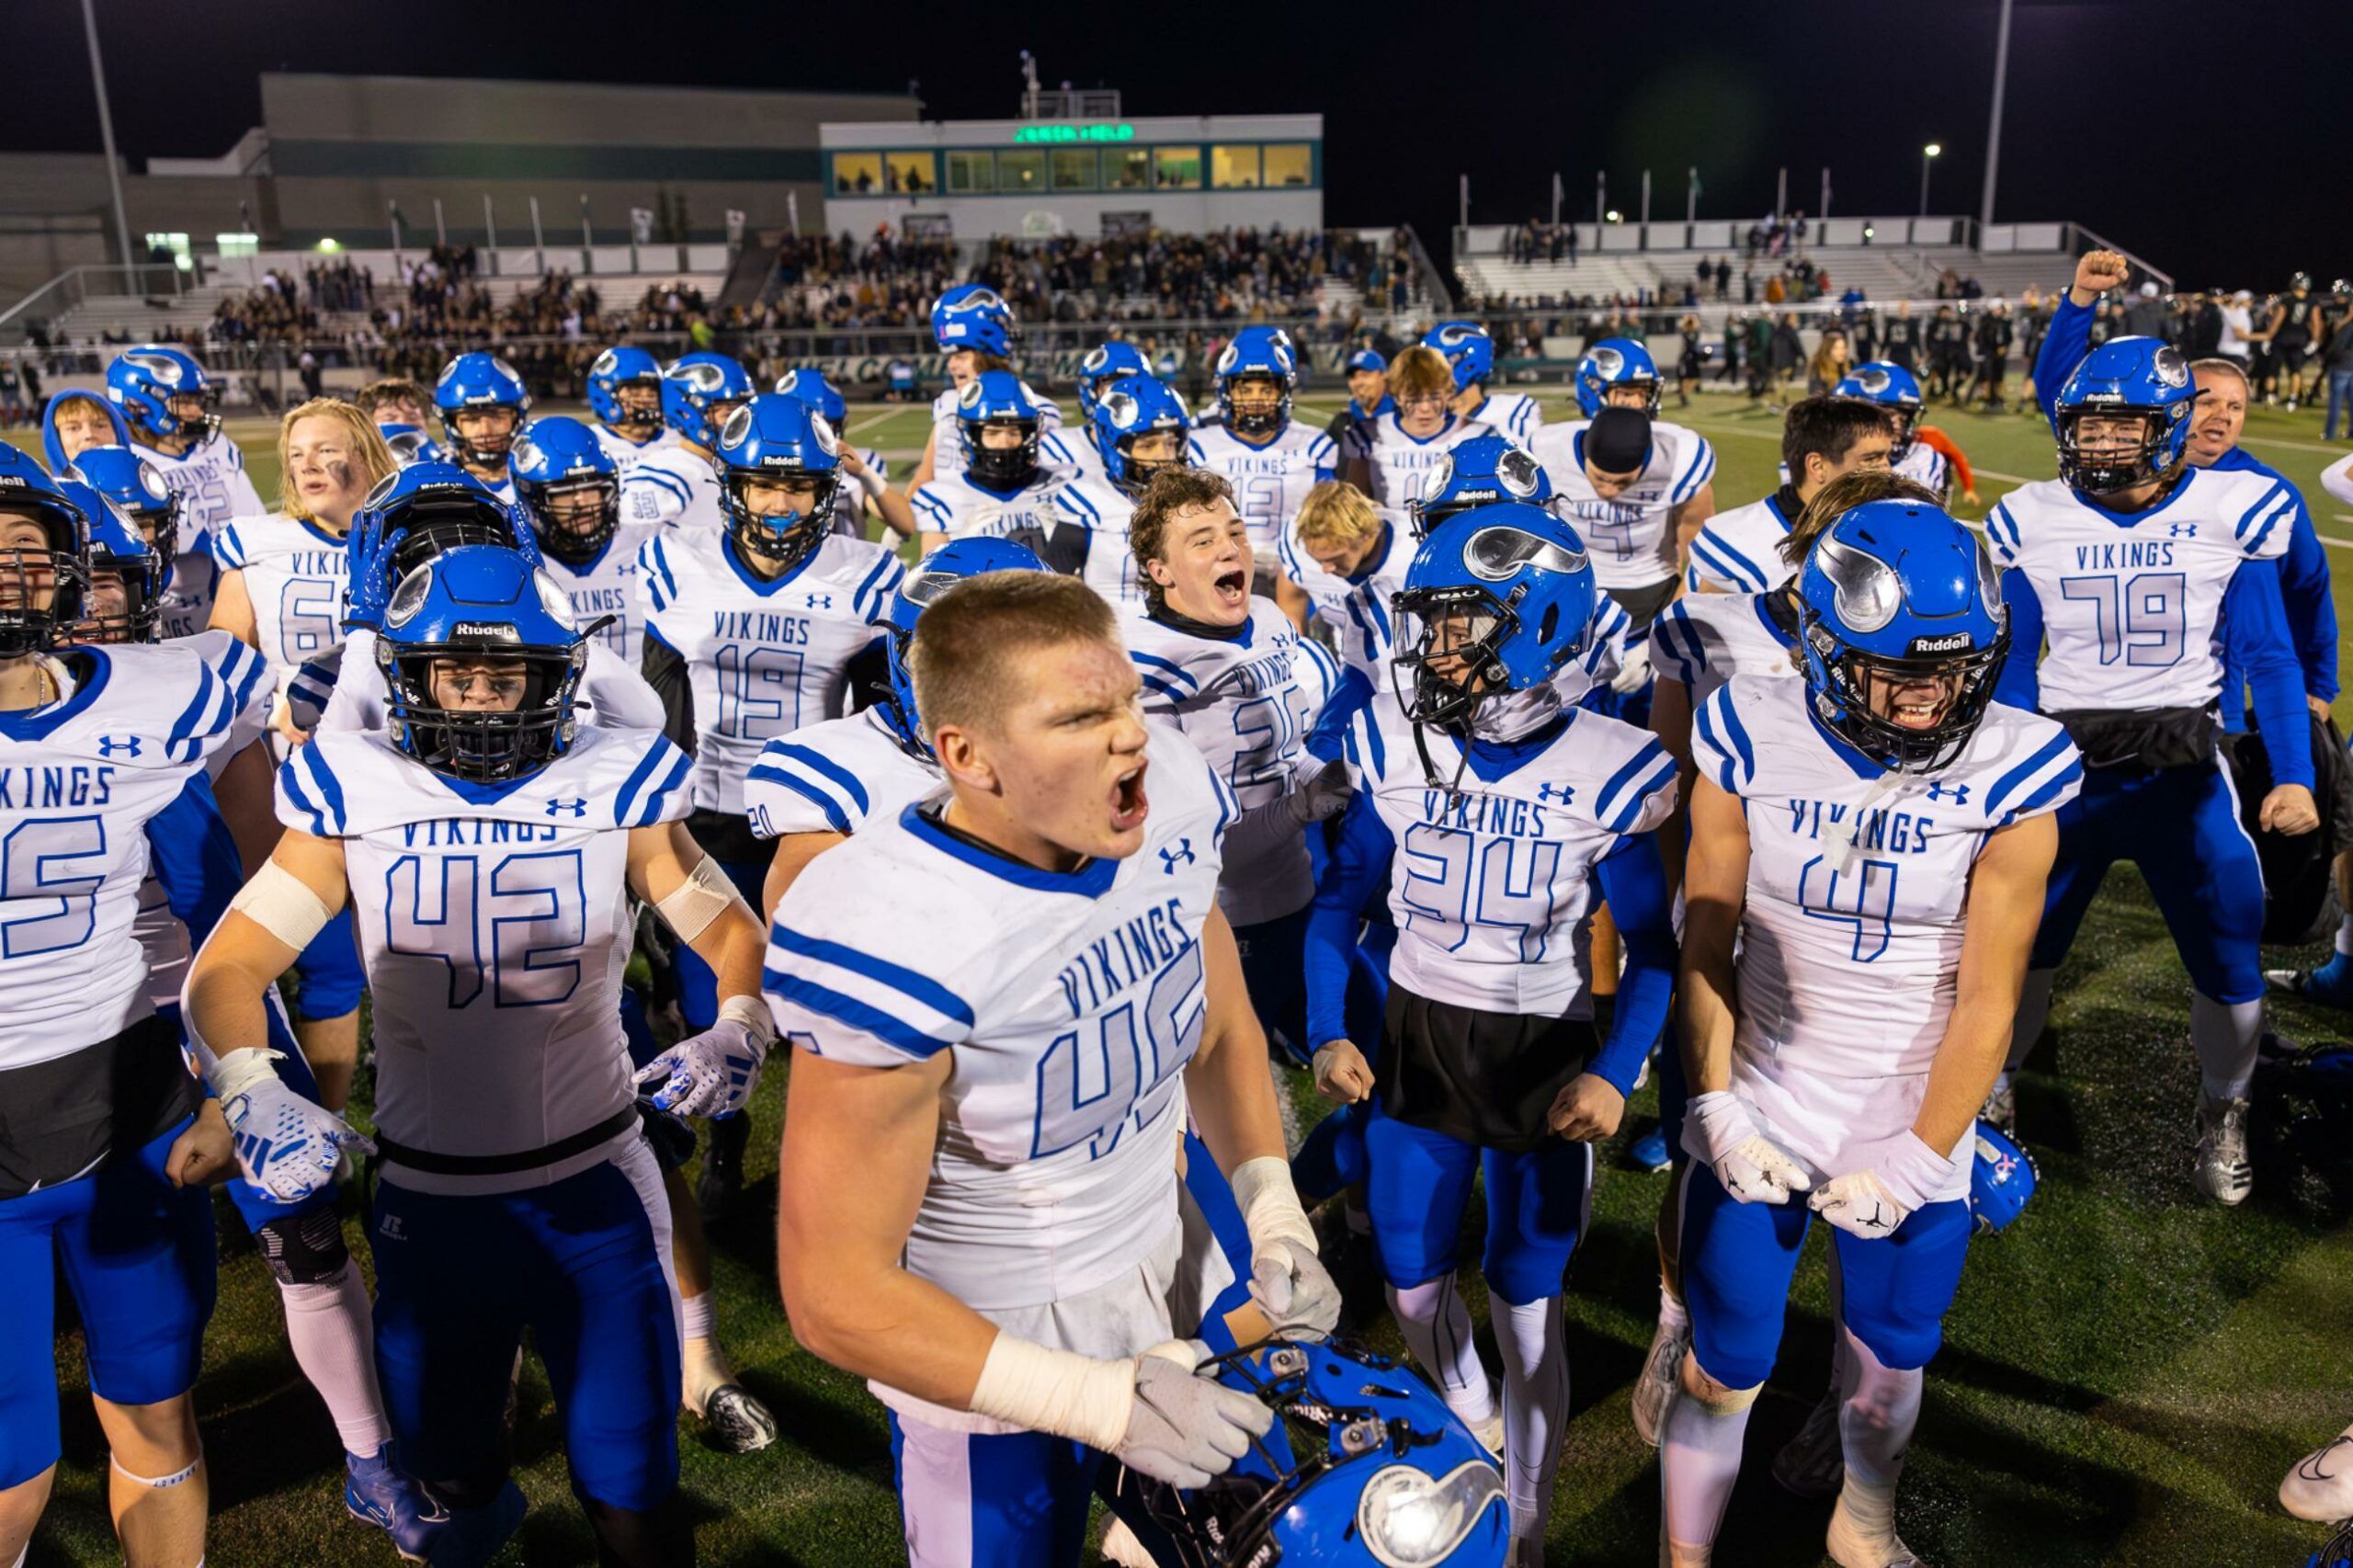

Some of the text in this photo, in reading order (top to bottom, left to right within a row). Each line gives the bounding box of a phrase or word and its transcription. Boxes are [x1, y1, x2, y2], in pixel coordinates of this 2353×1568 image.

[765, 456, 801, 466] Riddell
[1227, 457, 1288, 476] VIKINGS
[1459, 490, 1496, 500] Riddell
[291, 552, 350, 574] VIKIN
[2075, 541, 2174, 570] VIKINGS
[570, 588, 625, 613] KINGS
[278, 578, 351, 665] 6
[713, 611, 811, 645] VIKINGS
[2060, 572, 2187, 666] 79
[1915, 634, 1970, 653] Riddell
[715, 643, 805, 741] 19
[0, 767, 115, 809] KINGS
[1424, 790, 1548, 838] VIKINGS
[404, 820, 557, 848] VIKINGS
[1798, 853, 1899, 964] 4
[385, 849, 587, 1009] 42
[1058, 897, 1192, 1018] VIKINGS
